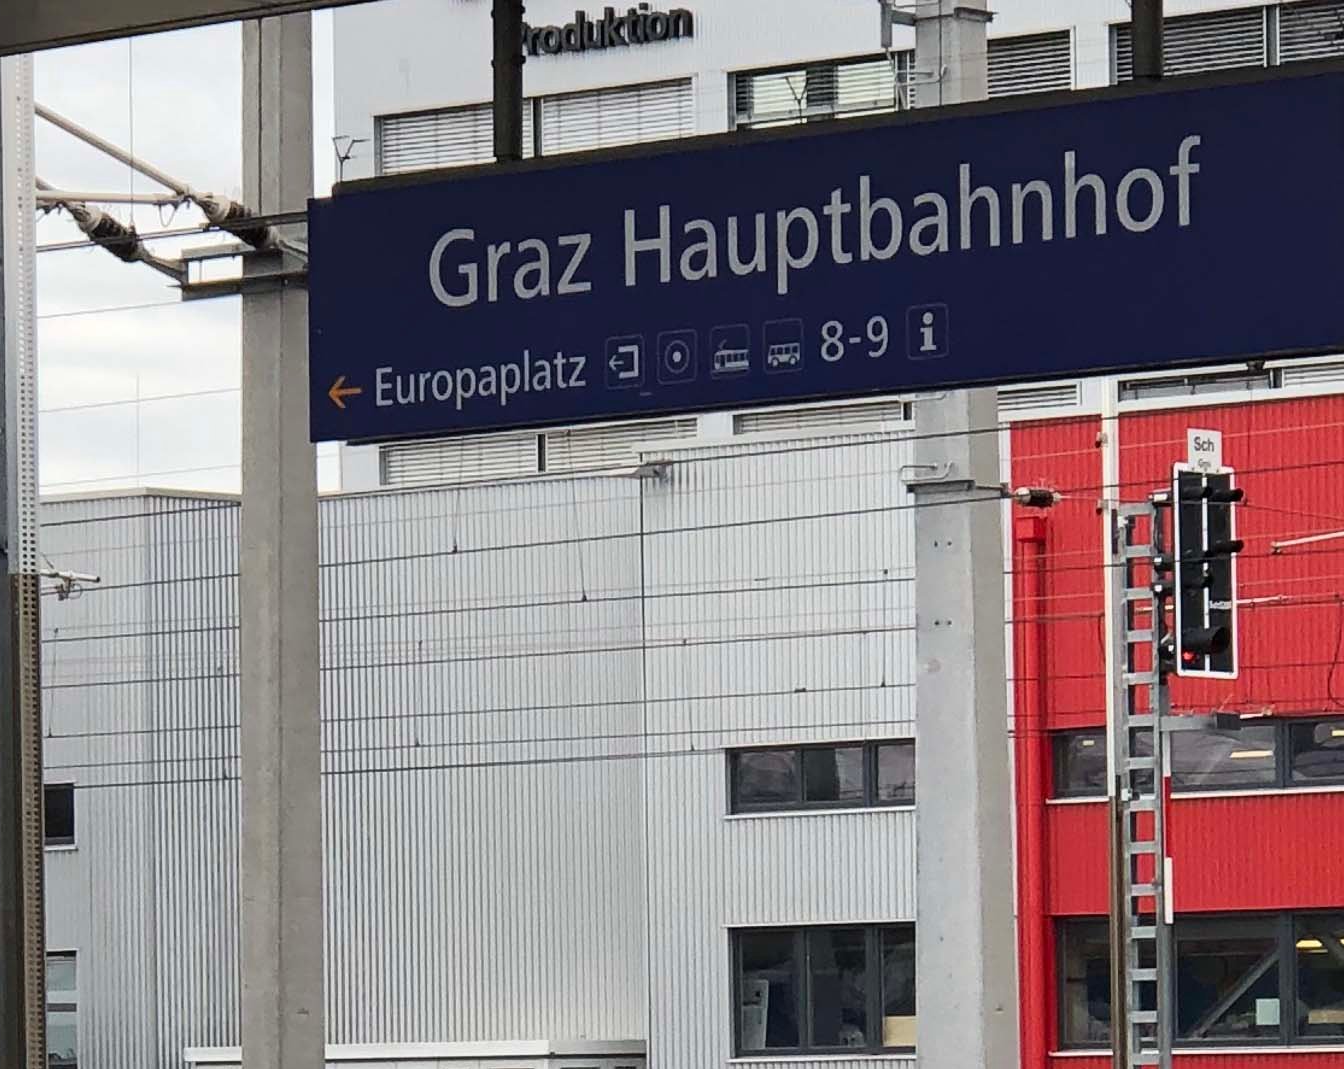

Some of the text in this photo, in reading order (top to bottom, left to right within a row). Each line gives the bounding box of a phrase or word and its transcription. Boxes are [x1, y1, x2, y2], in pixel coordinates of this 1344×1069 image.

[522, 2, 694, 56] roduktion
[429, 135, 1201, 307] Graz Hauptbahnhof
[375, 349, 586, 410] Europaplatz
[821, 316, 889, 362] 8-9
[1193, 435, 1215, 453] Sch
